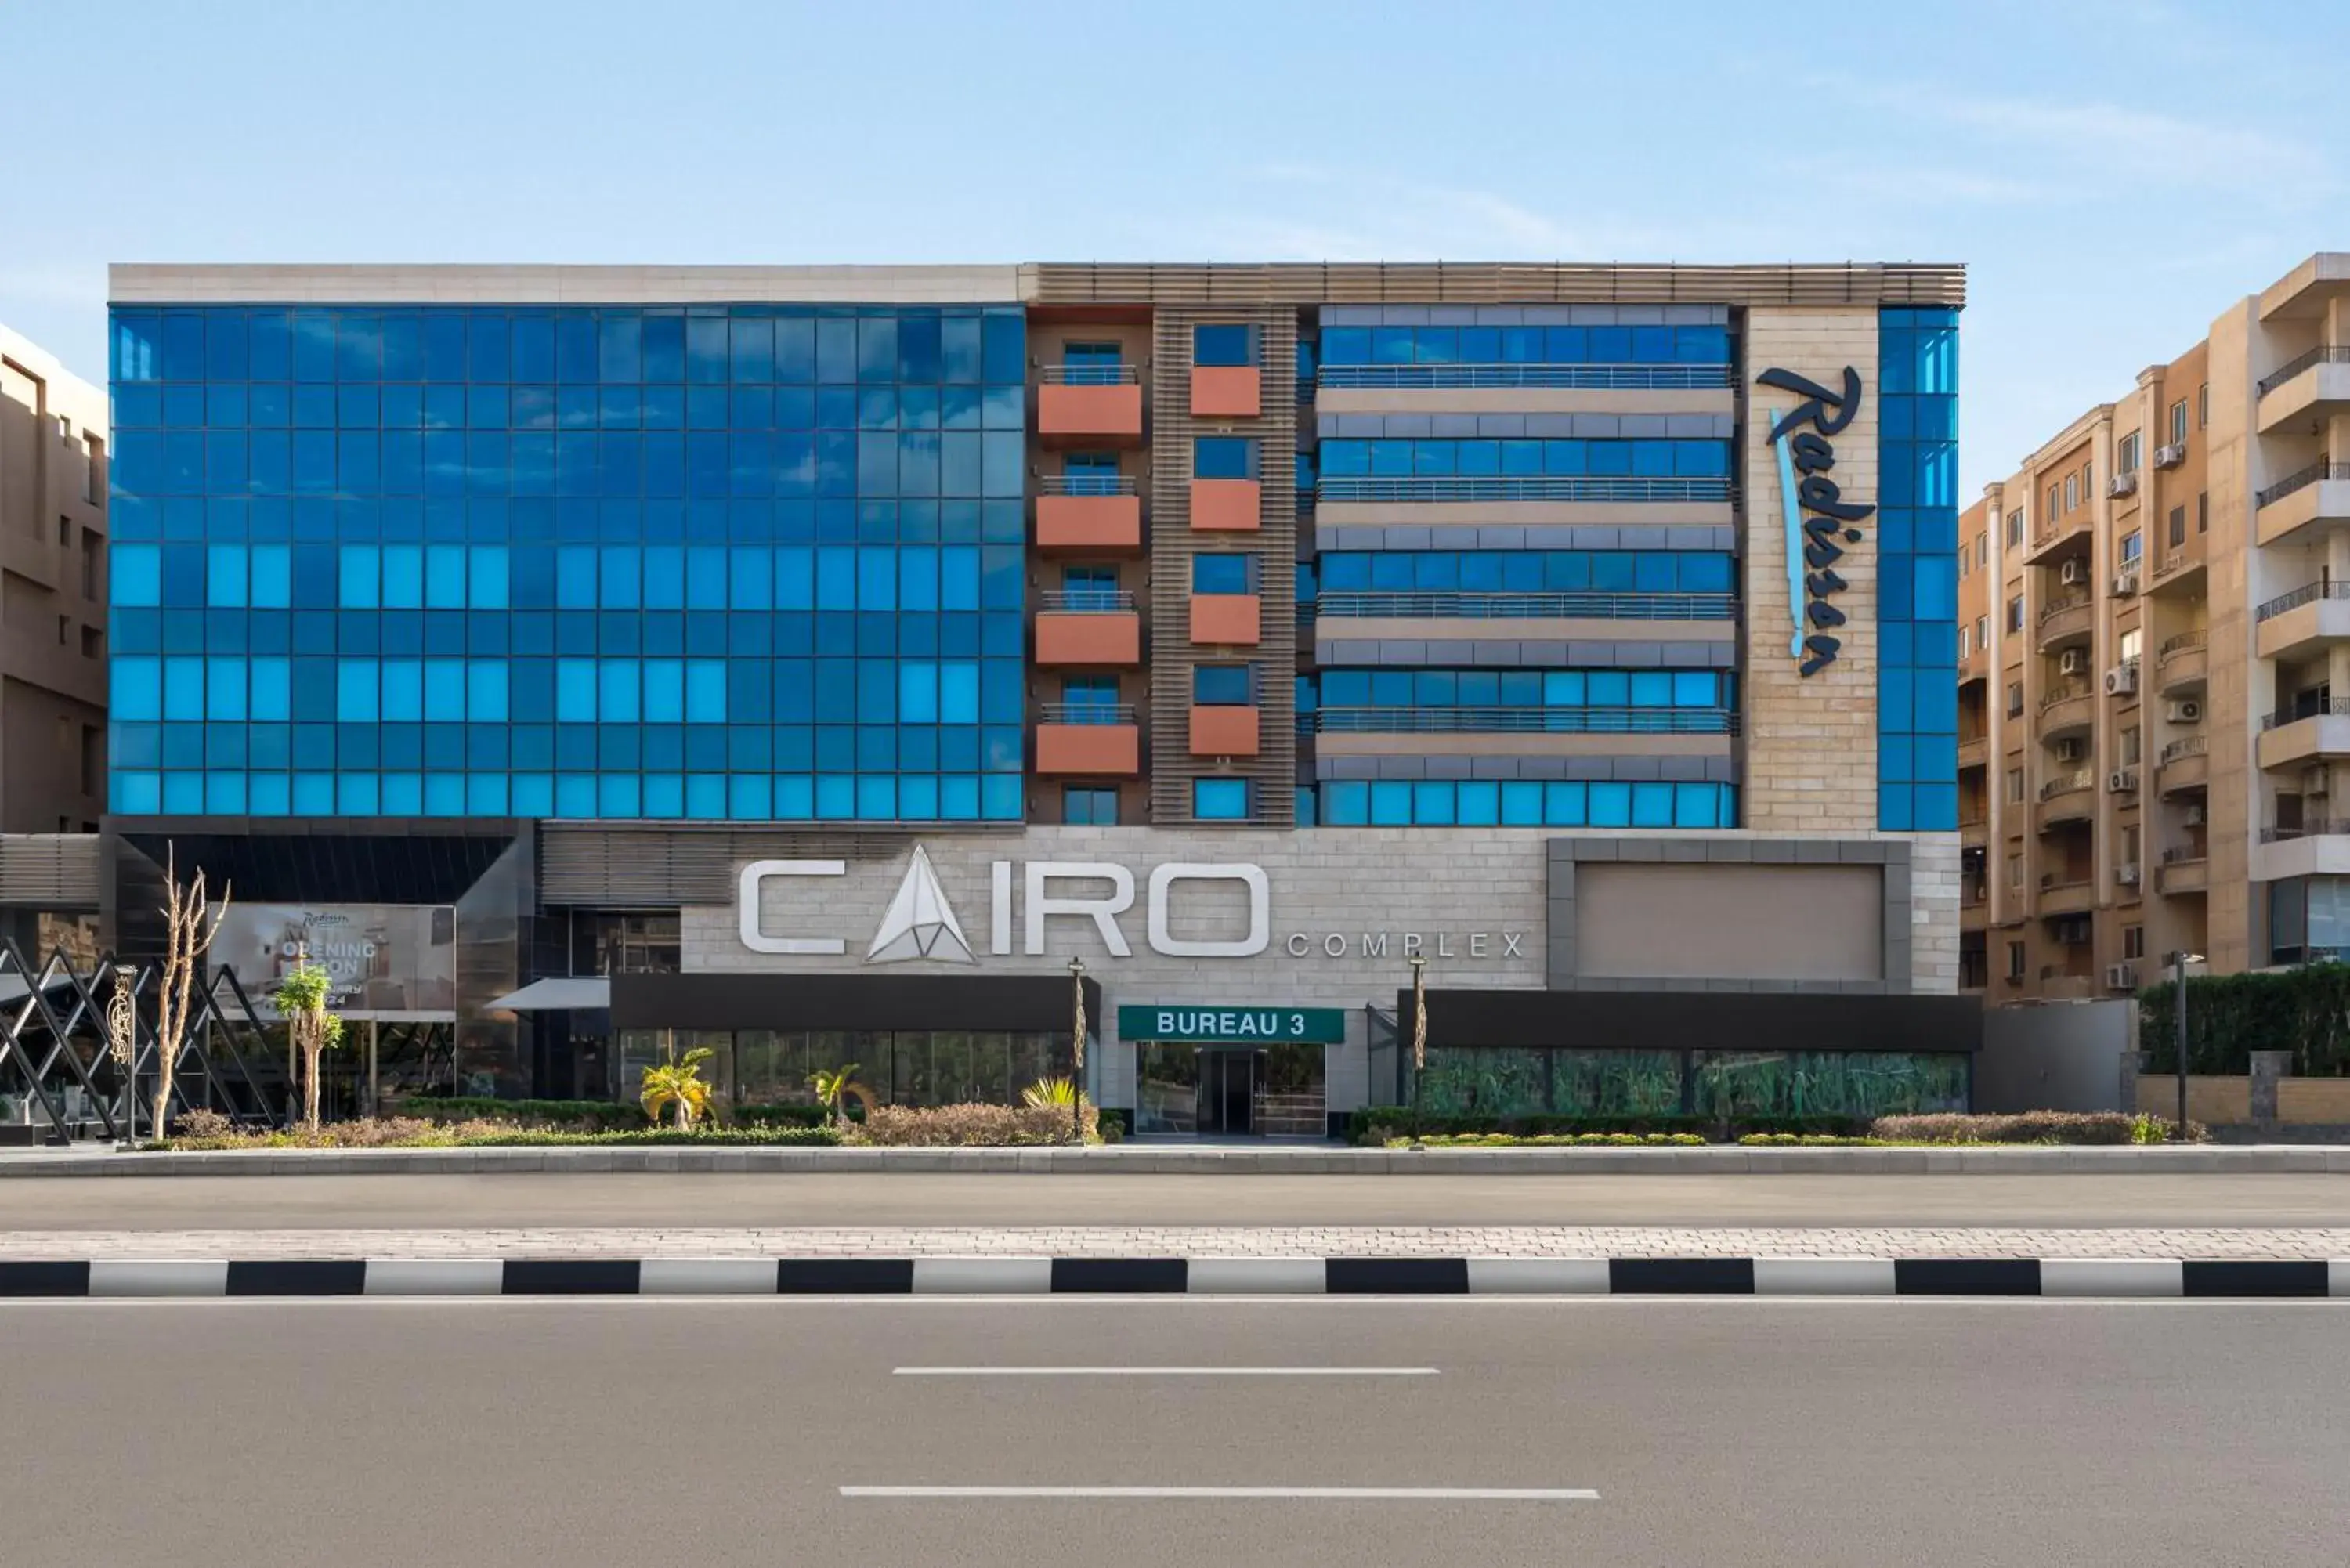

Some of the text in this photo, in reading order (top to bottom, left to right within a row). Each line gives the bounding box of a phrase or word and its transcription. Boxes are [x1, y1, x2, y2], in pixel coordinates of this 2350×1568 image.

[1756, 365, 1876, 677] Radisson
[739, 844, 1524, 964] CAIRO COMPLEX
[283, 941, 375, 957] OPENING
[1157, 1013, 1306, 1035] BUREAU 3
